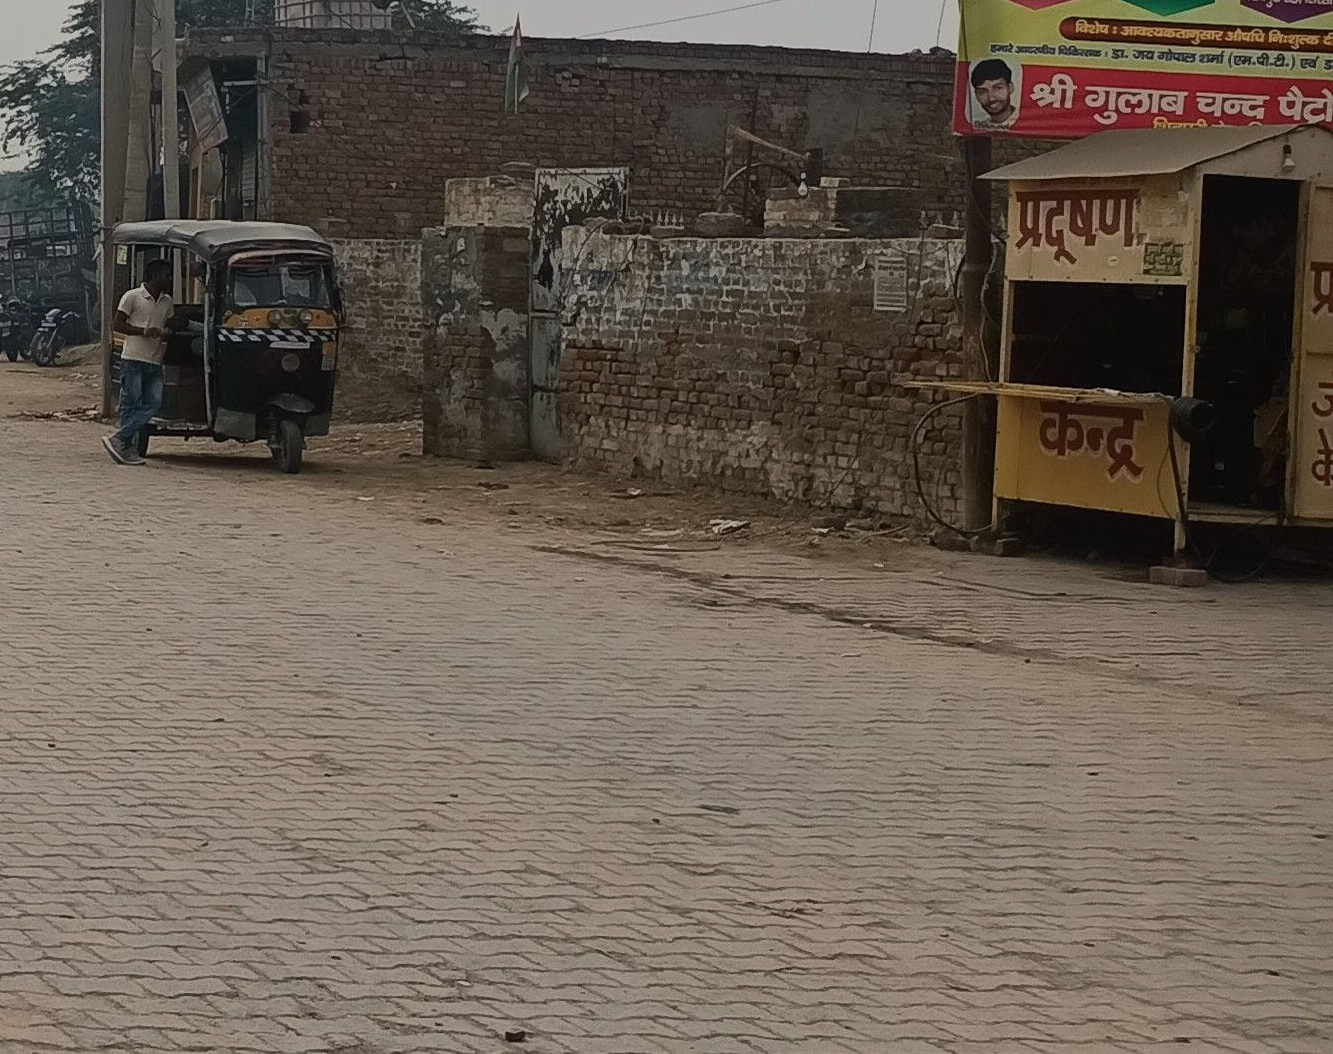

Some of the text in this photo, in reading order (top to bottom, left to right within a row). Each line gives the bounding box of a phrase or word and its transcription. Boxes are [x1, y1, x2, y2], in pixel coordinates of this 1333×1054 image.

[1075, 19, 1110, 35] विशेष
[1133, 50, 1155, 60] जय
[1157, 48, 1196, 63] गोपाल
[1198, 50, 1225, 65] शर्मा
[1030, 73, 1078, 109] श्री
[1084, 85, 1189, 126] गुलाब
[1195, 91, 1271, 120] चन्द
[1015, 189, 1142, 265] प्रदूषण
